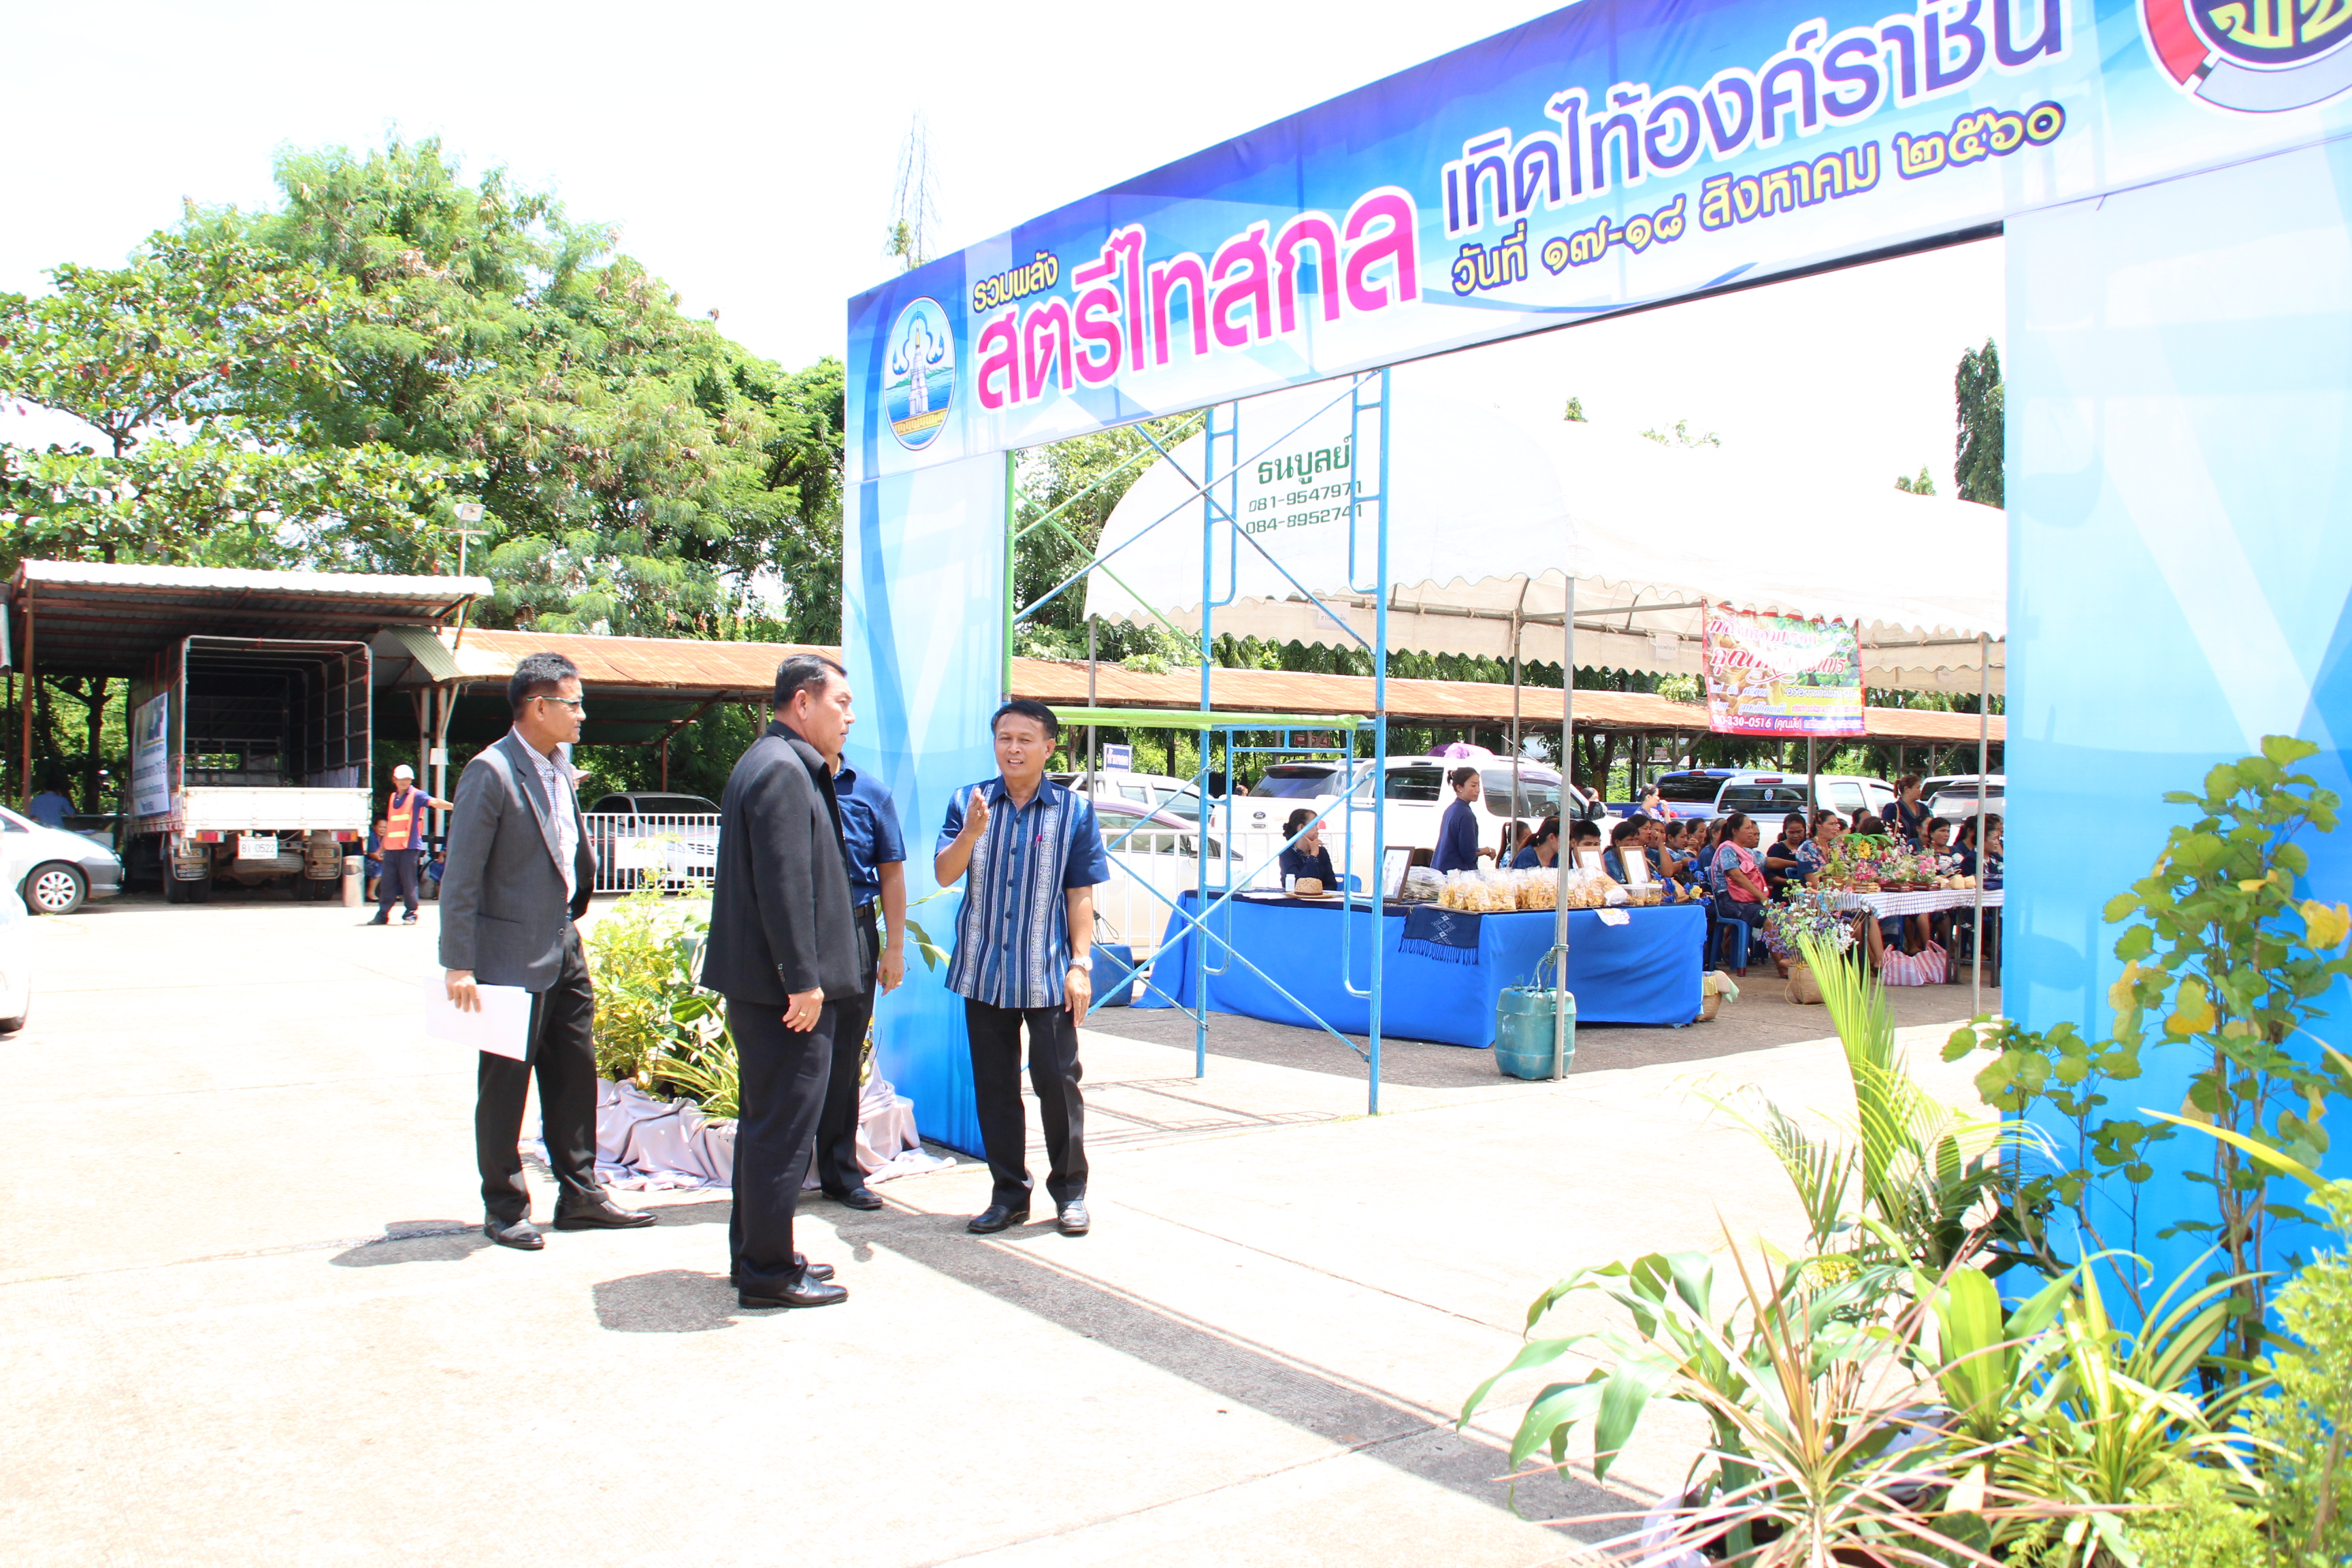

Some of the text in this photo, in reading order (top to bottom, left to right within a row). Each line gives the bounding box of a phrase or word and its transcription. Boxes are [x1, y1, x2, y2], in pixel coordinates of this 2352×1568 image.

[1452, 101, 2065, 295] วันที่ ๑๗-๑๘ สิงหาคม ๒๕๖๐
[974, 250, 1059, 313] รวมพลัง
[977, 193, 1418, 410] สตรีไทสกล
[1245, 504, 1362, 534] 084-8952741
[1248, 480, 1362, 512] 081-9547971
